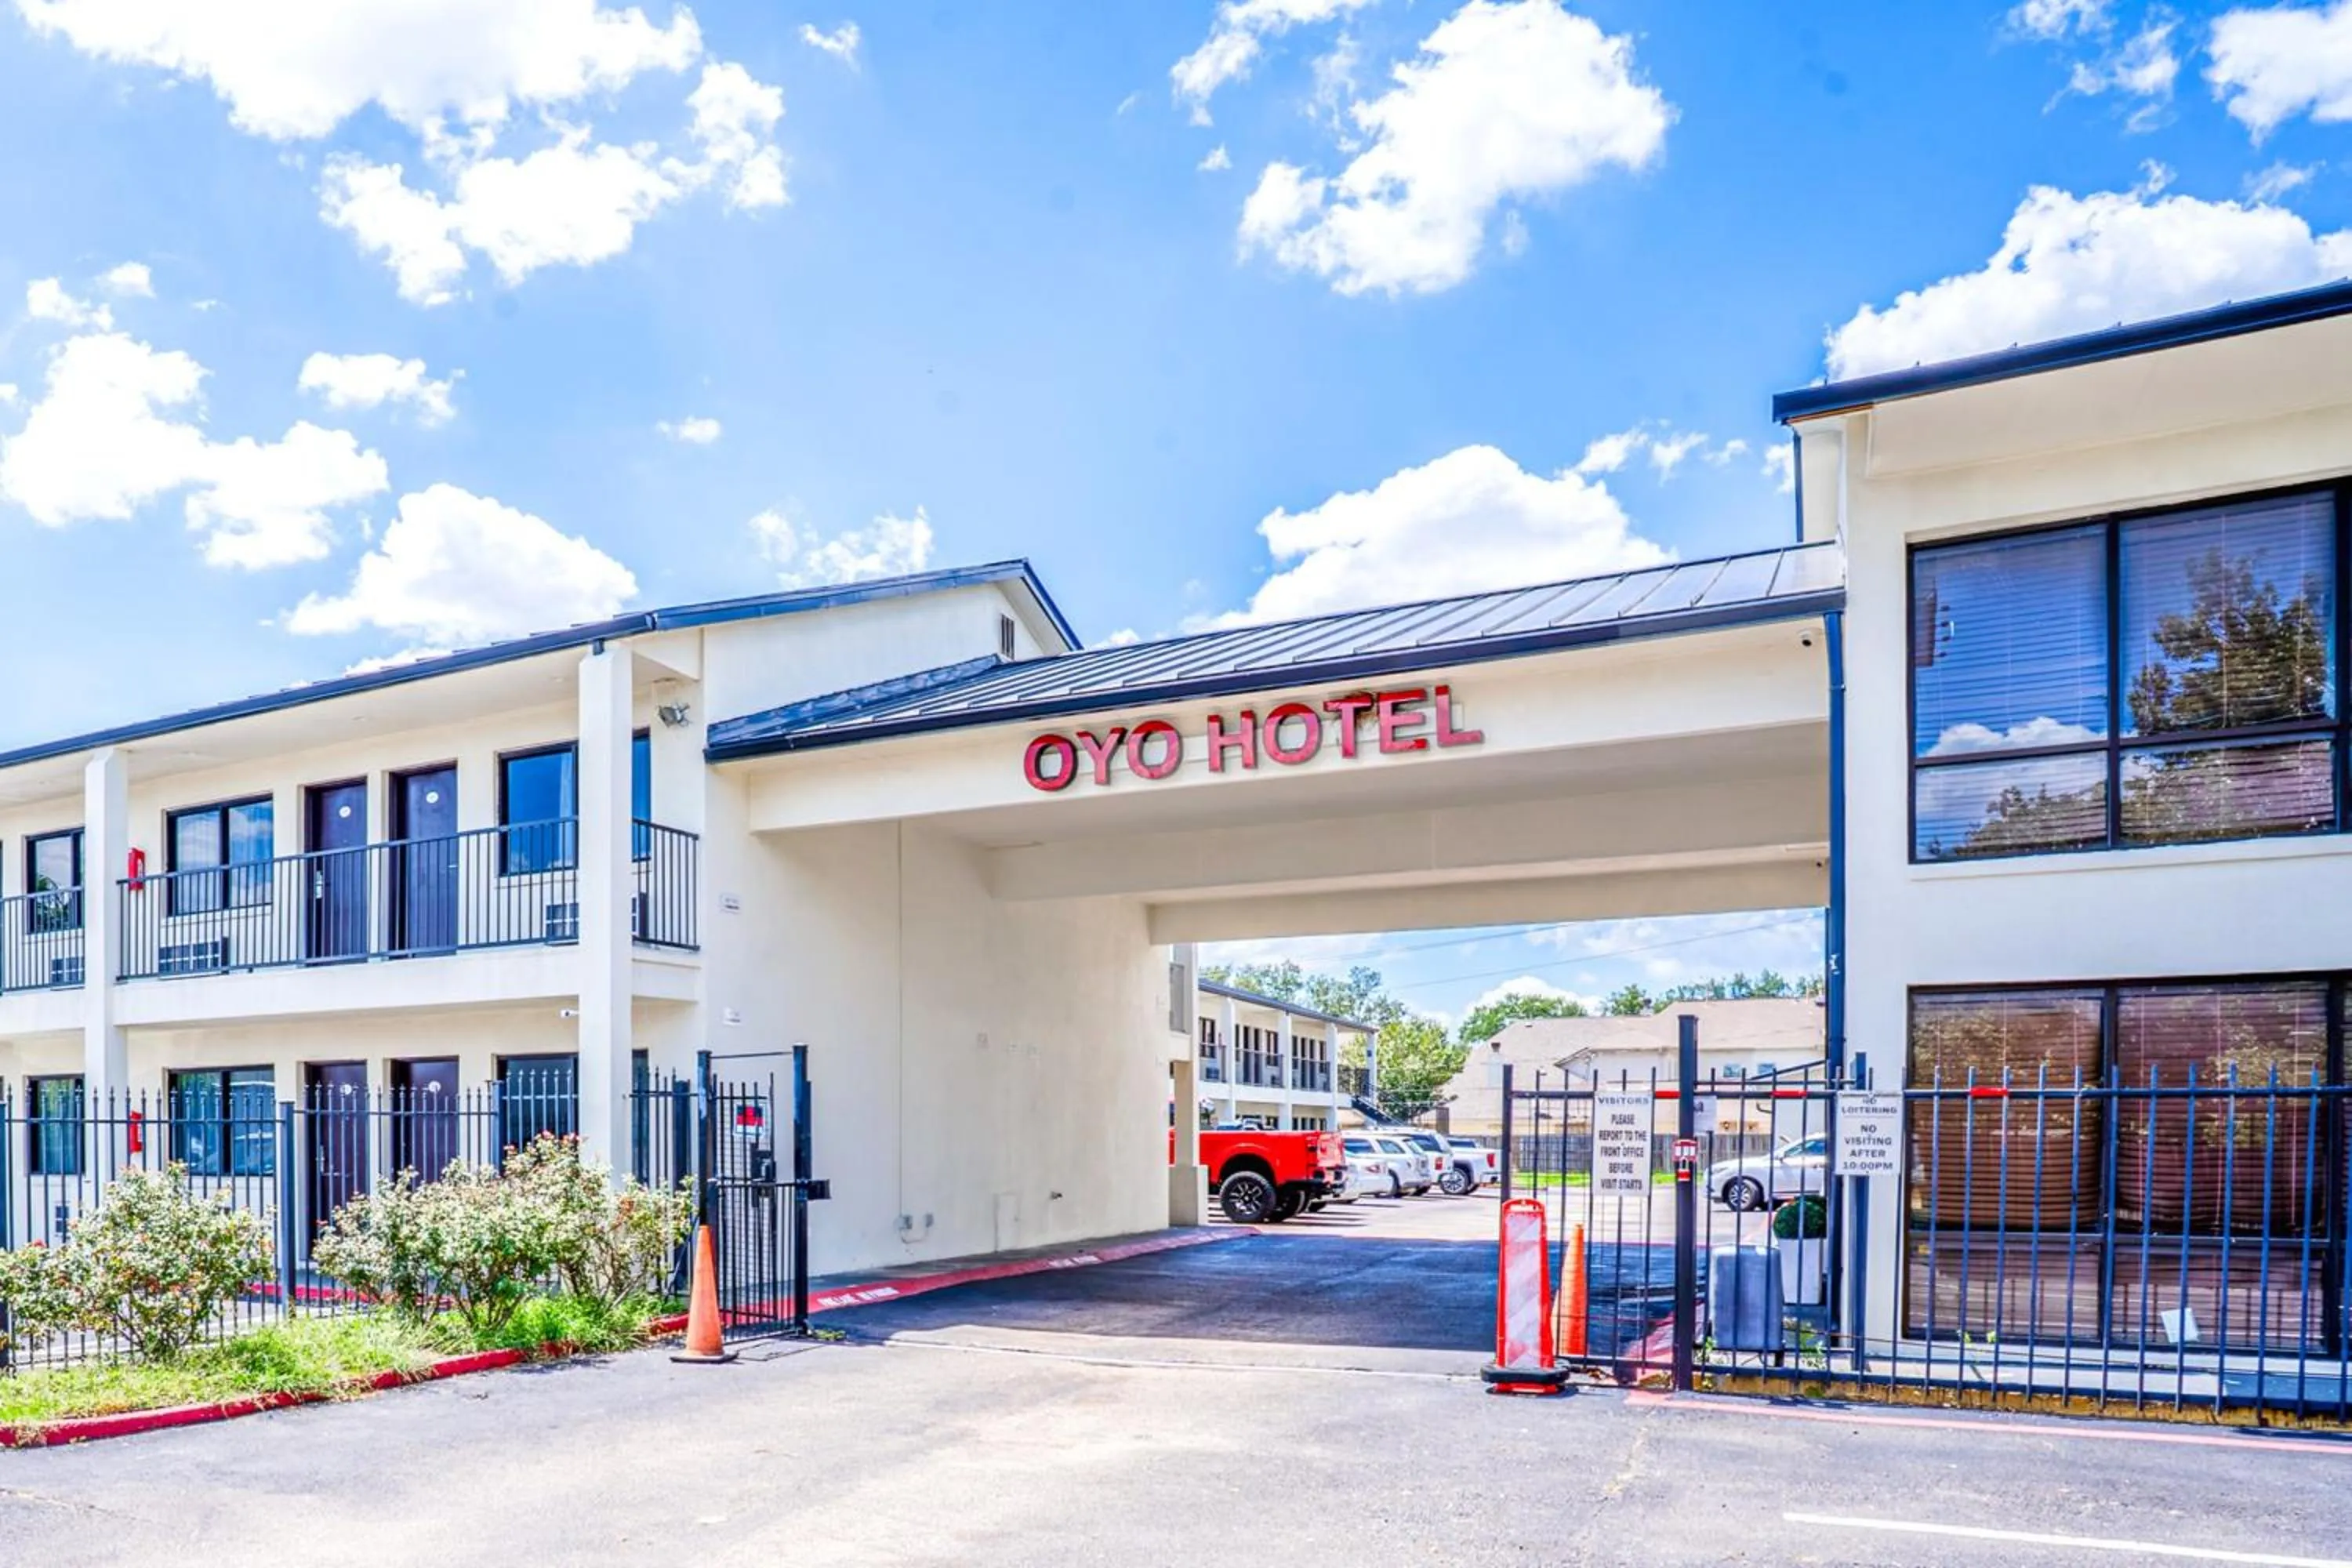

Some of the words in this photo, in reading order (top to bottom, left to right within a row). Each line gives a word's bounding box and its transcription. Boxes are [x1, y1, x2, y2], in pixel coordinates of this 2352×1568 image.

[1024, 719, 1183, 791] OYO
[1207, 684, 1484, 772] HOTEL
[1612, 1114, 1635, 1125] PLEASE
[1860, 1124, 1877, 1133] NO
[1599, 1130, 1623, 1141] REPORT
[1624, 1130, 1633, 1141] TO
[1635, 1130, 1647, 1142] THE
[1844, 1136, 1892, 1145] VISITING
[1601, 1146, 1621, 1157] FRONT
[1622, 1146, 1644, 1158] OFFICE
[1849, 1149, 1886, 1158] AFTER
[1609, 1163, 1634, 1174] BEFORE
[1601, 1179, 1617, 1189] VISIT
[1618, 1179, 1642, 1190] STARTS
